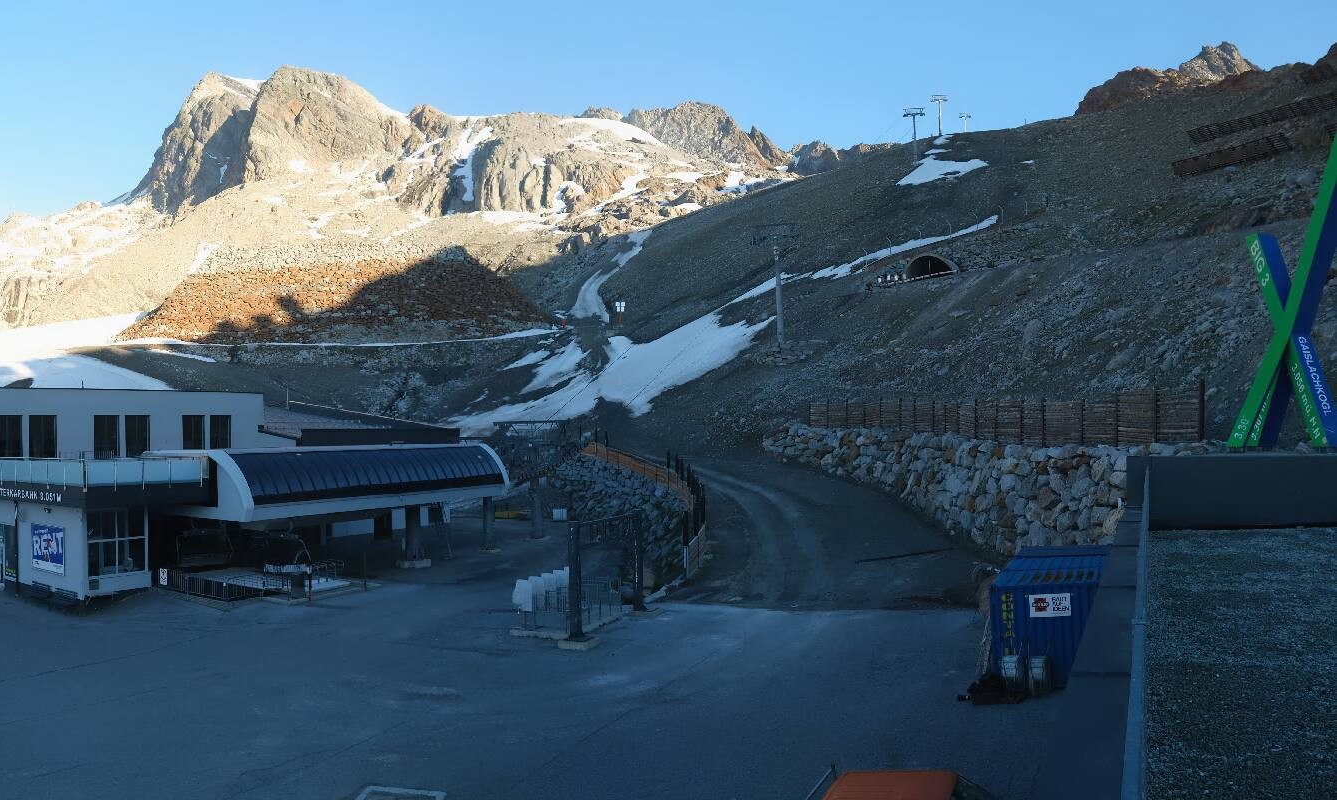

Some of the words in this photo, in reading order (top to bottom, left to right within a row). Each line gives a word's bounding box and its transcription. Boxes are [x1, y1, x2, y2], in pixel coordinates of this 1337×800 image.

[1250, 240, 1265, 273] BIG
[1261, 273, 1270, 287] 3
[1298, 336, 1332, 416] GAISLACHKOGL
